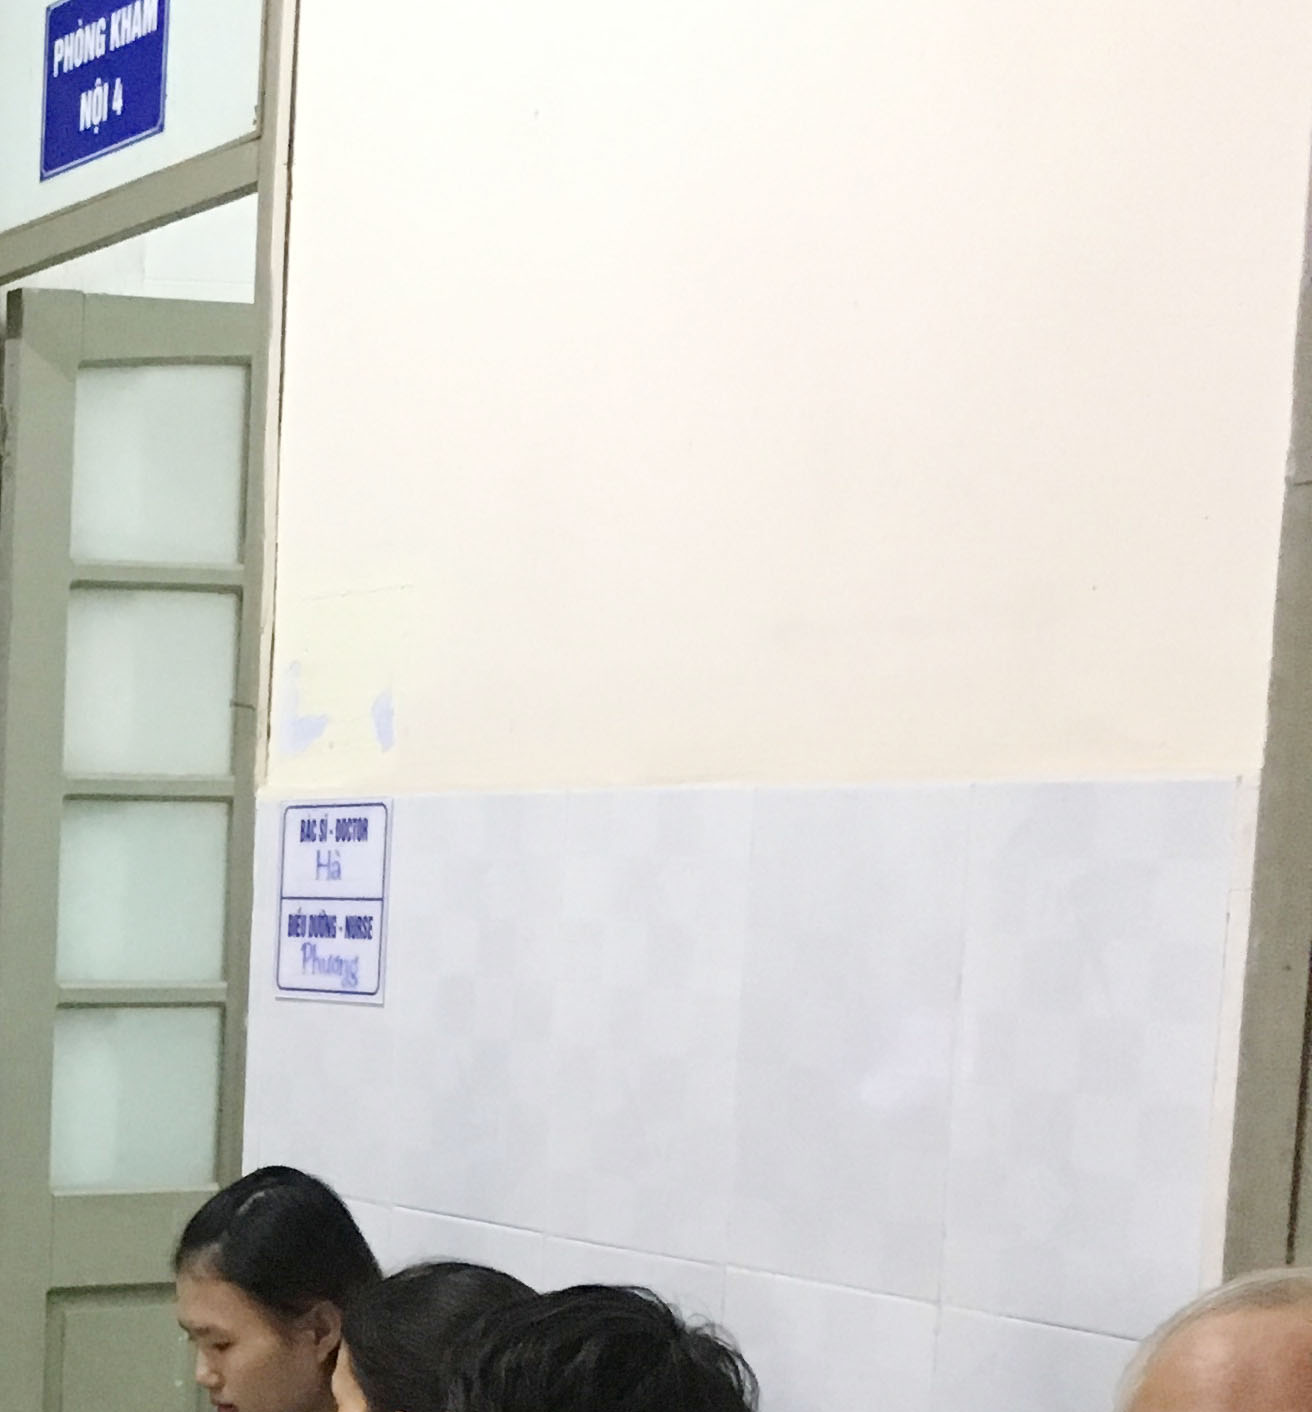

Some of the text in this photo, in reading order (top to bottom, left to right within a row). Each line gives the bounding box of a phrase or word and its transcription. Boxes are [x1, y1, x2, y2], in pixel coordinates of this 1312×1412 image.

[53, 17, 107, 78] PHÒNG
[79, 77, 124, 134] NỘI 4
[335, 818, 369, 842] DOCTOR
[315, 850, 342, 881] Hà
[344, 916, 374, 940] NURSE
